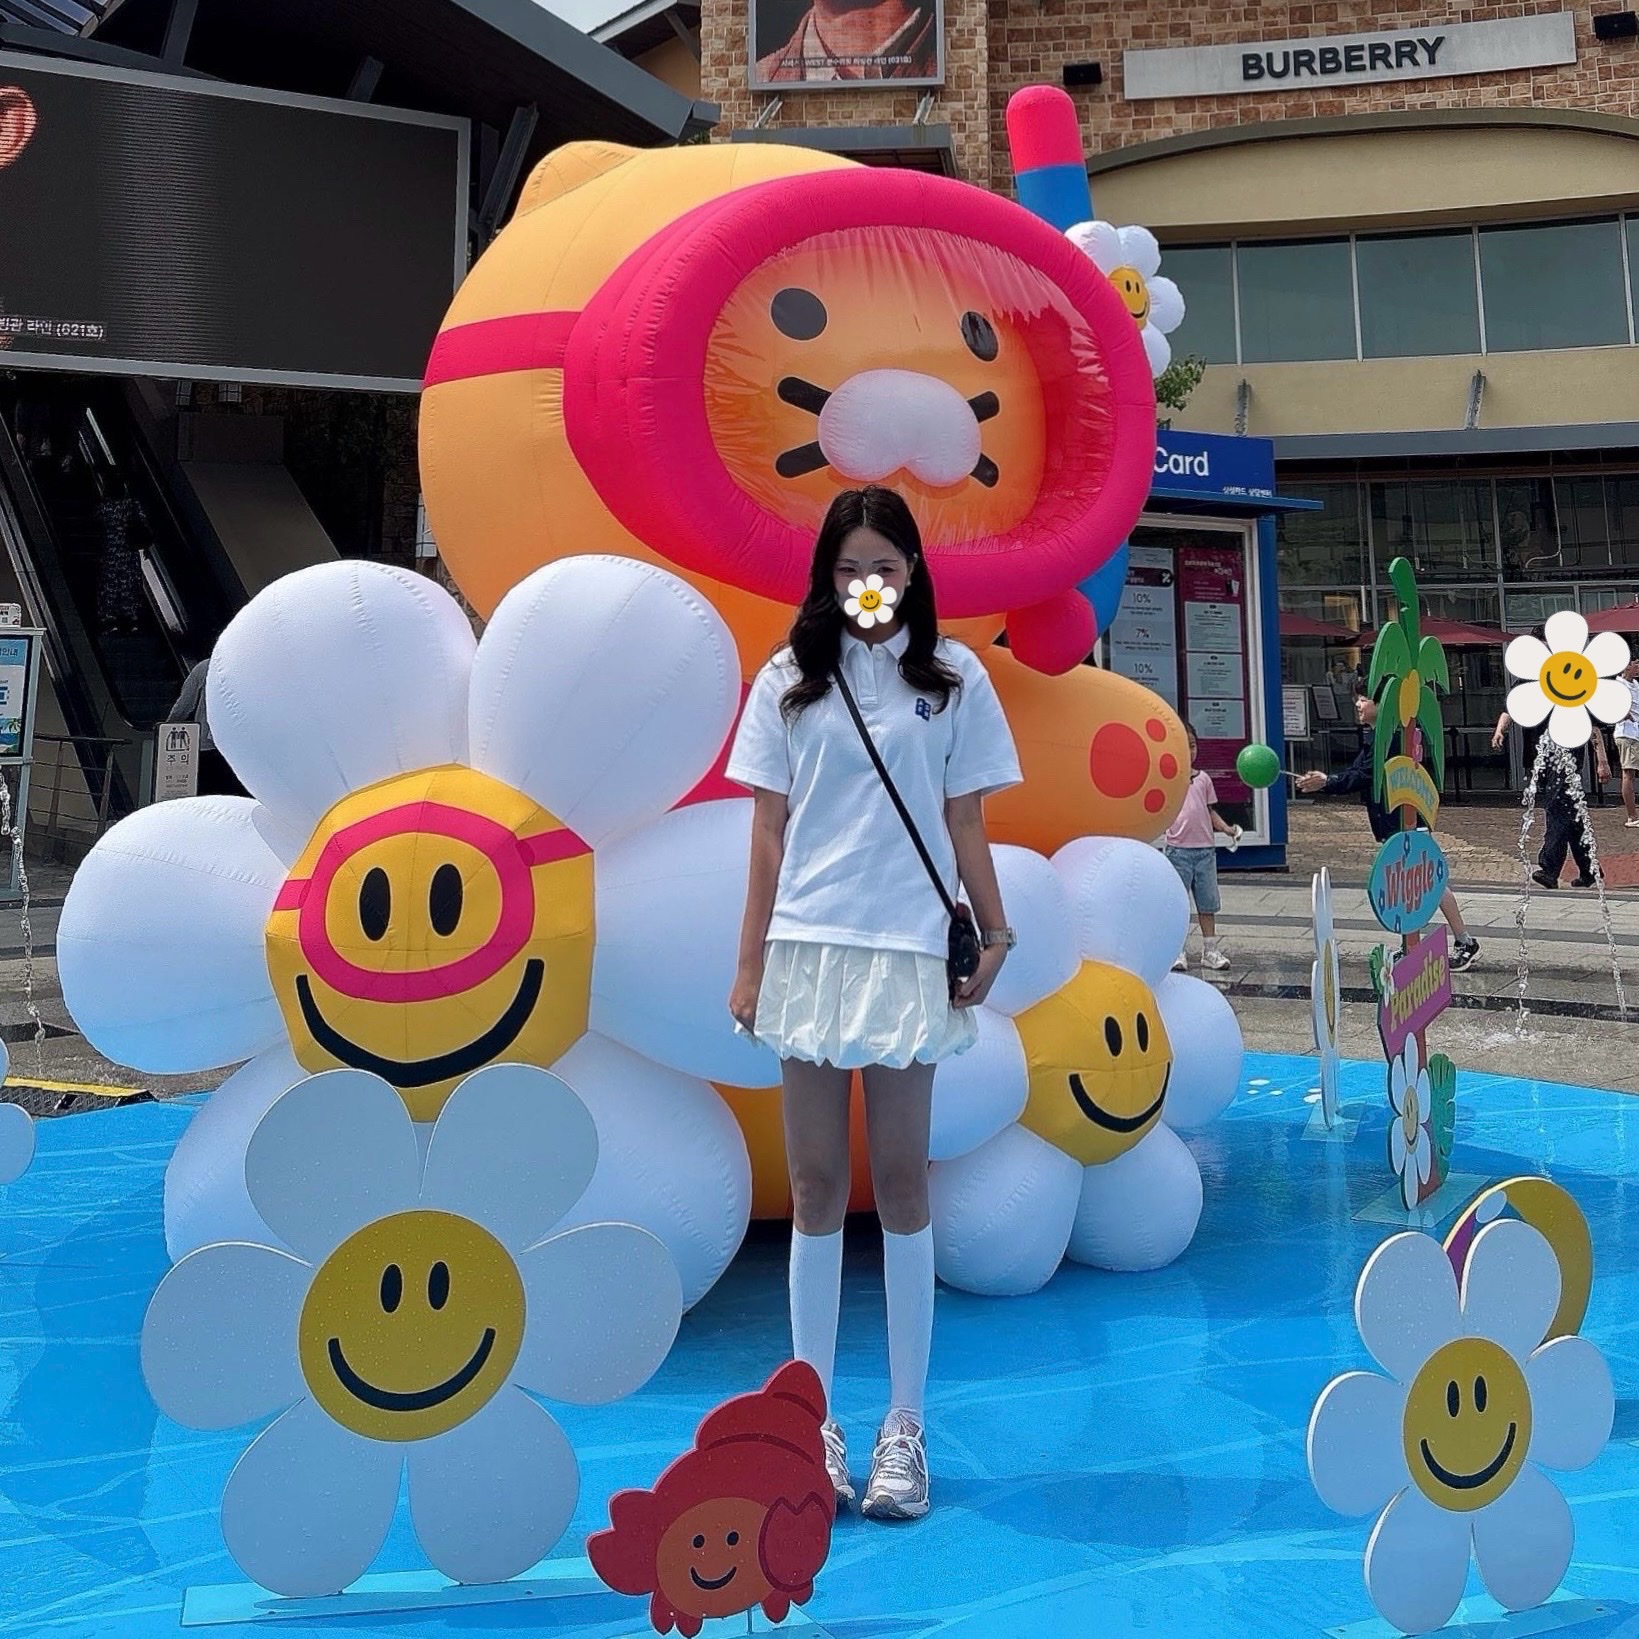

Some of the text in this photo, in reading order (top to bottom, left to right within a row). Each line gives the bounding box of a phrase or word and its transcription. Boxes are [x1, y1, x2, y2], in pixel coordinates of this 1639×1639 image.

[1242, 36, 1445, 80] BURBERRY
[27, 320, 52, 335] 라인
[57, 323, 104, 339] (621호)
[1154, 446, 1209, 476] Card
[1133, 593, 1151, 604] 10%
[1134, 663, 1153, 674] 10%
[1384, 851, 1434, 913] Wiggle
[1390, 952, 1445, 1033] Paradise
